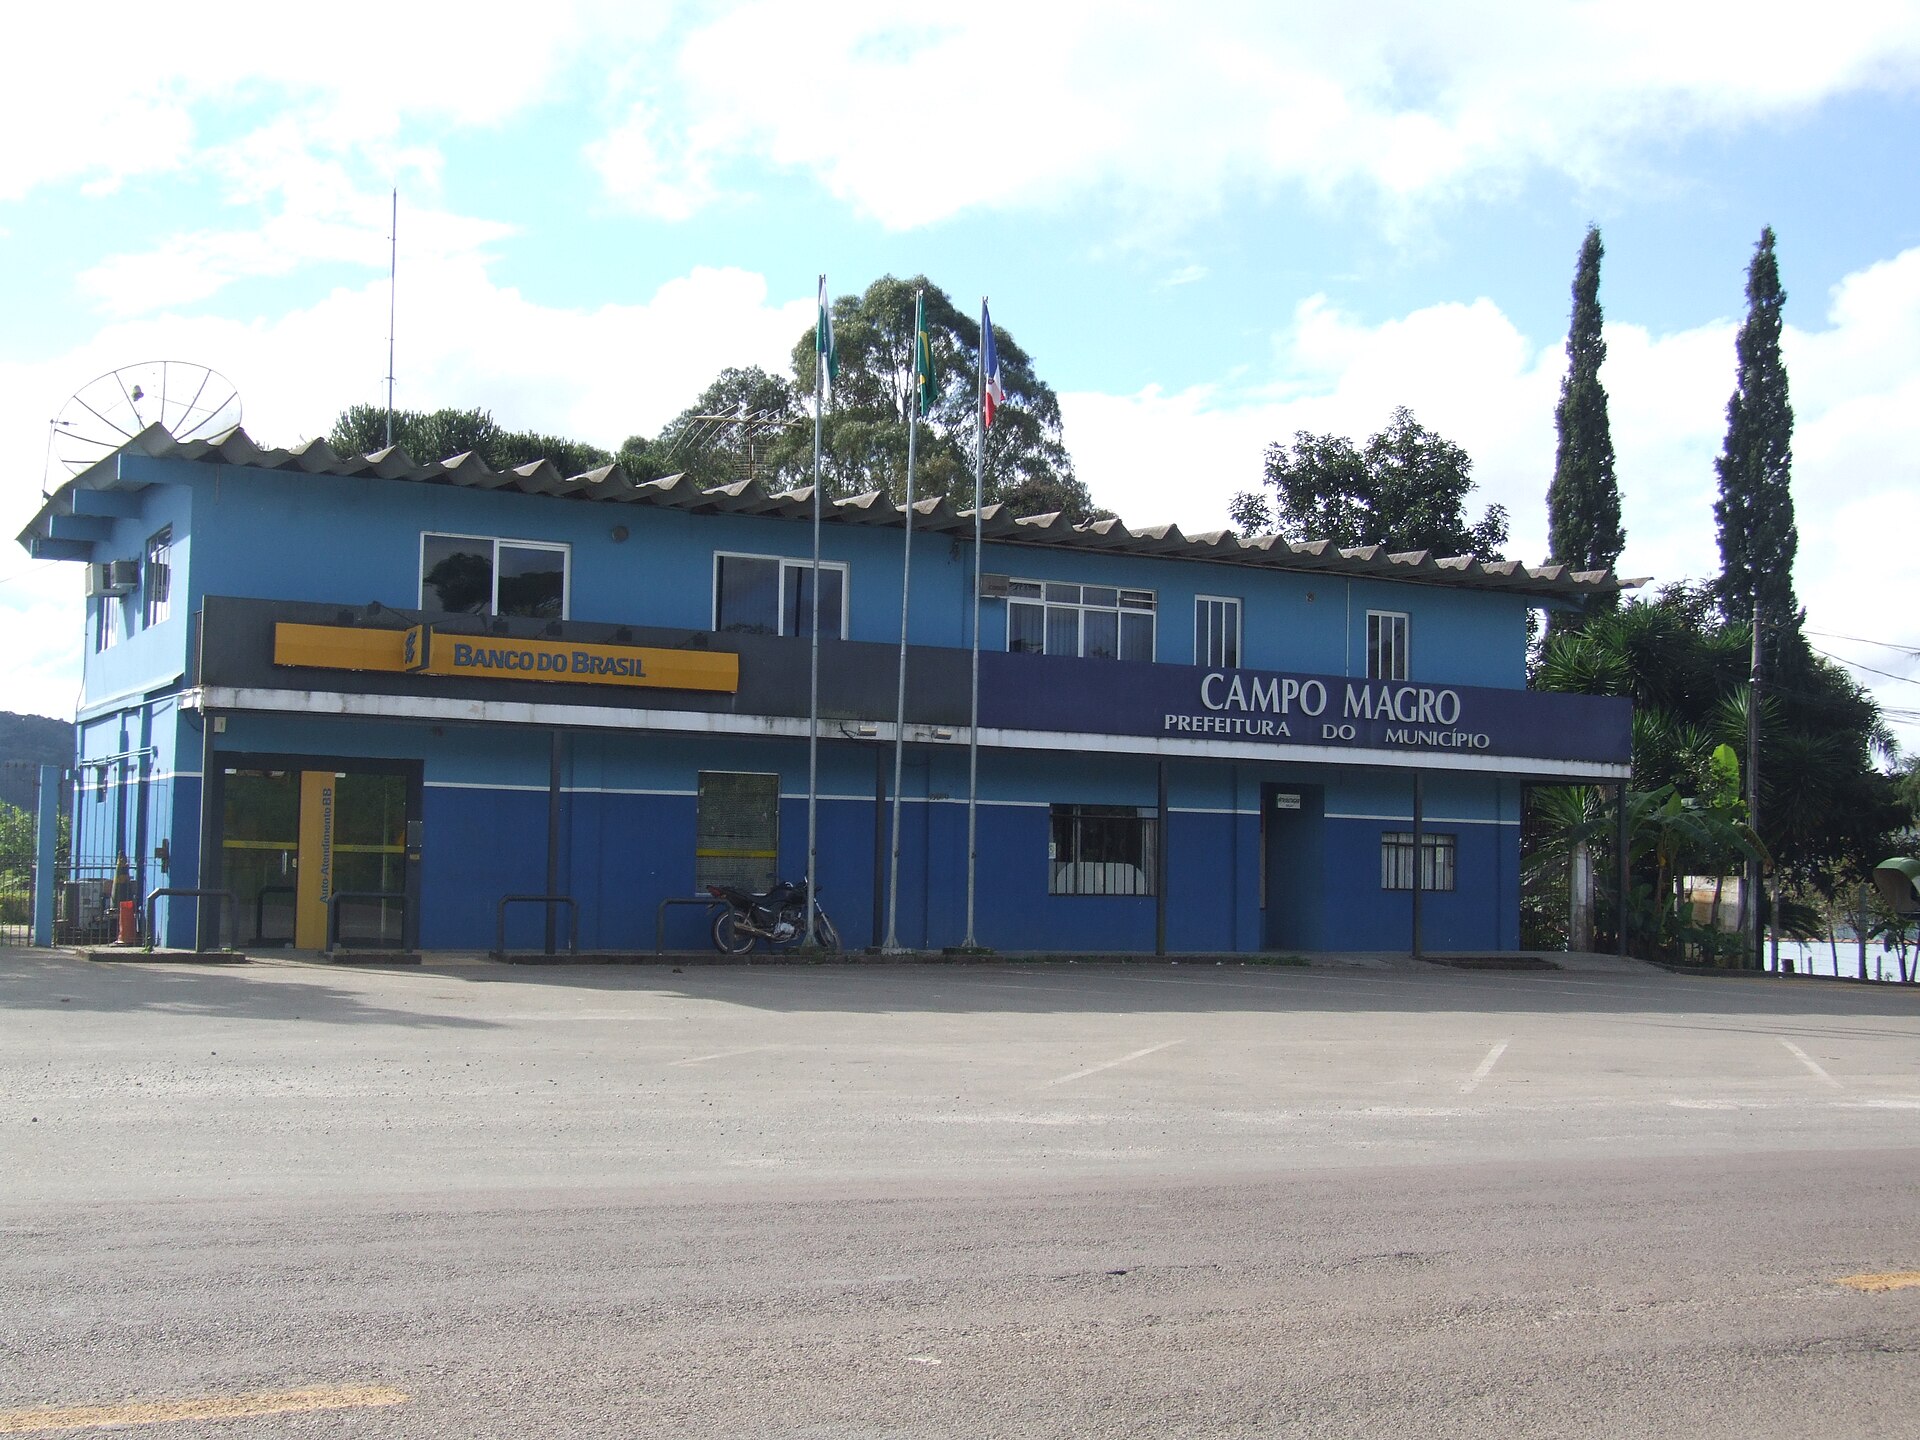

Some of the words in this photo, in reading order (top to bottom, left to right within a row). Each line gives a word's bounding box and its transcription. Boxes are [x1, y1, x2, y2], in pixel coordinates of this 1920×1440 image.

[454, 643, 534, 670] BANCO
[537, 651, 568, 672] DO
[571, 651, 647, 678] BRASIL
[1201, 672, 1327, 717] CAMPO
[1343, 683, 1461, 726] MAGRO
[1164, 713, 1291, 737] PREFEITURA
[1322, 723, 1356, 741] DO
[1385, 727, 1491, 749] MUNICÍPIO
[322, 788, 331, 805] BB
